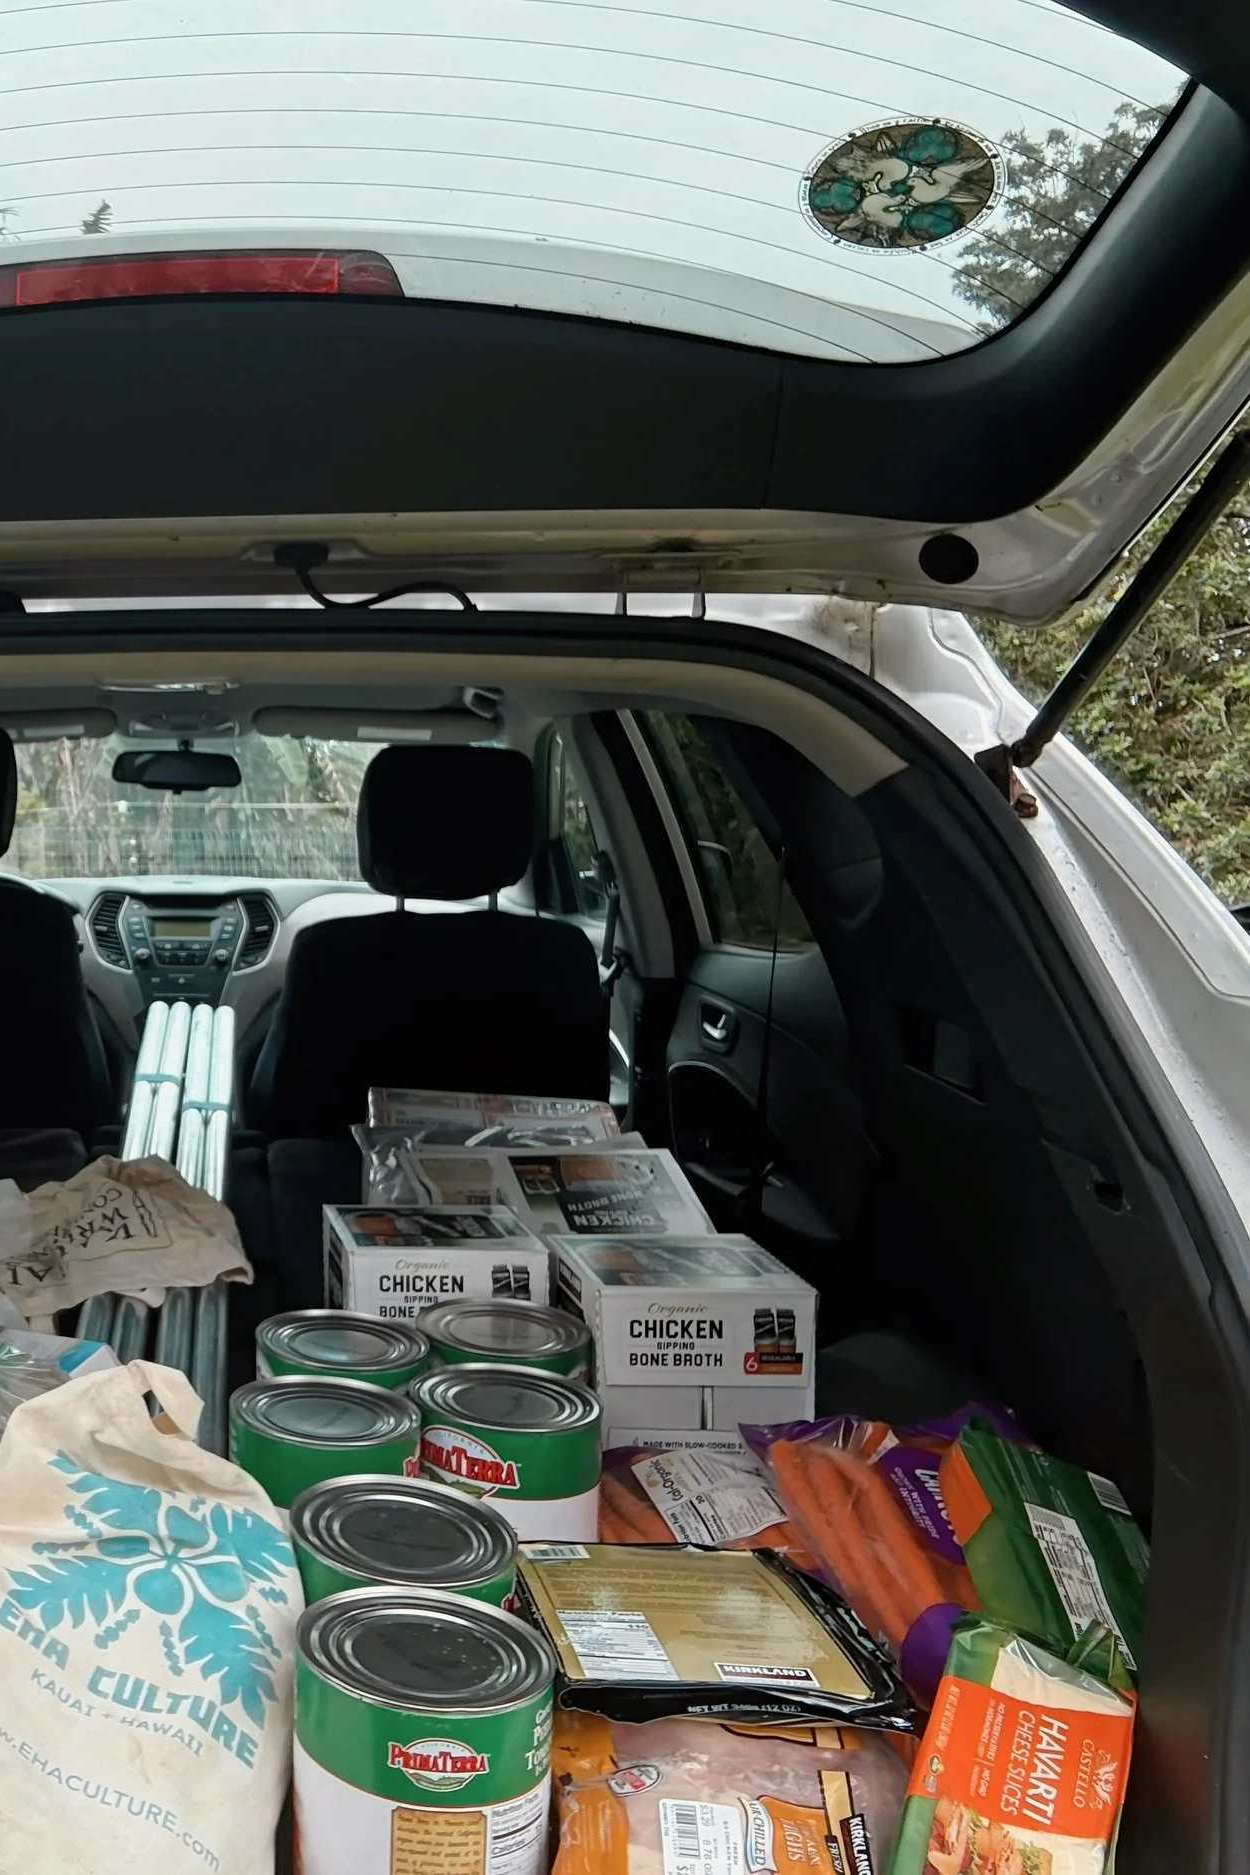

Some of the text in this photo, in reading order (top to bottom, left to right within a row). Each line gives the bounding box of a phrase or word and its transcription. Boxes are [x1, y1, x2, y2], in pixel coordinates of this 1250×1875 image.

[394, 1258, 450, 1273] Organic
[379, 1275, 464, 1293] CHICKEN
[379, 1306, 415, 1318] BONE
[647, 1302, 709, 1317] Organic
[629, 1319, 724, 1339] CHICKEN
[629, 1353, 723, 1367] BONE BROTH
[745, 1357, 758, 1373] 6
[665, 1441, 683, 1449] WITH
[723, 1664, 807, 1678] KIRKLAND
[31, 1668, 96, 1718] KAUAI
[120, 1715, 205, 1757] HAWAII
[87, 1665, 259, 1770] CULTURE
[1001, 1710, 1036, 1816] CHEESE SLICES
[1022, 1714, 1070, 1825] HAVARTI
[1073, 1738, 1095, 1809] CASTELLO
[827, 1842, 843, 1873] FRESH
